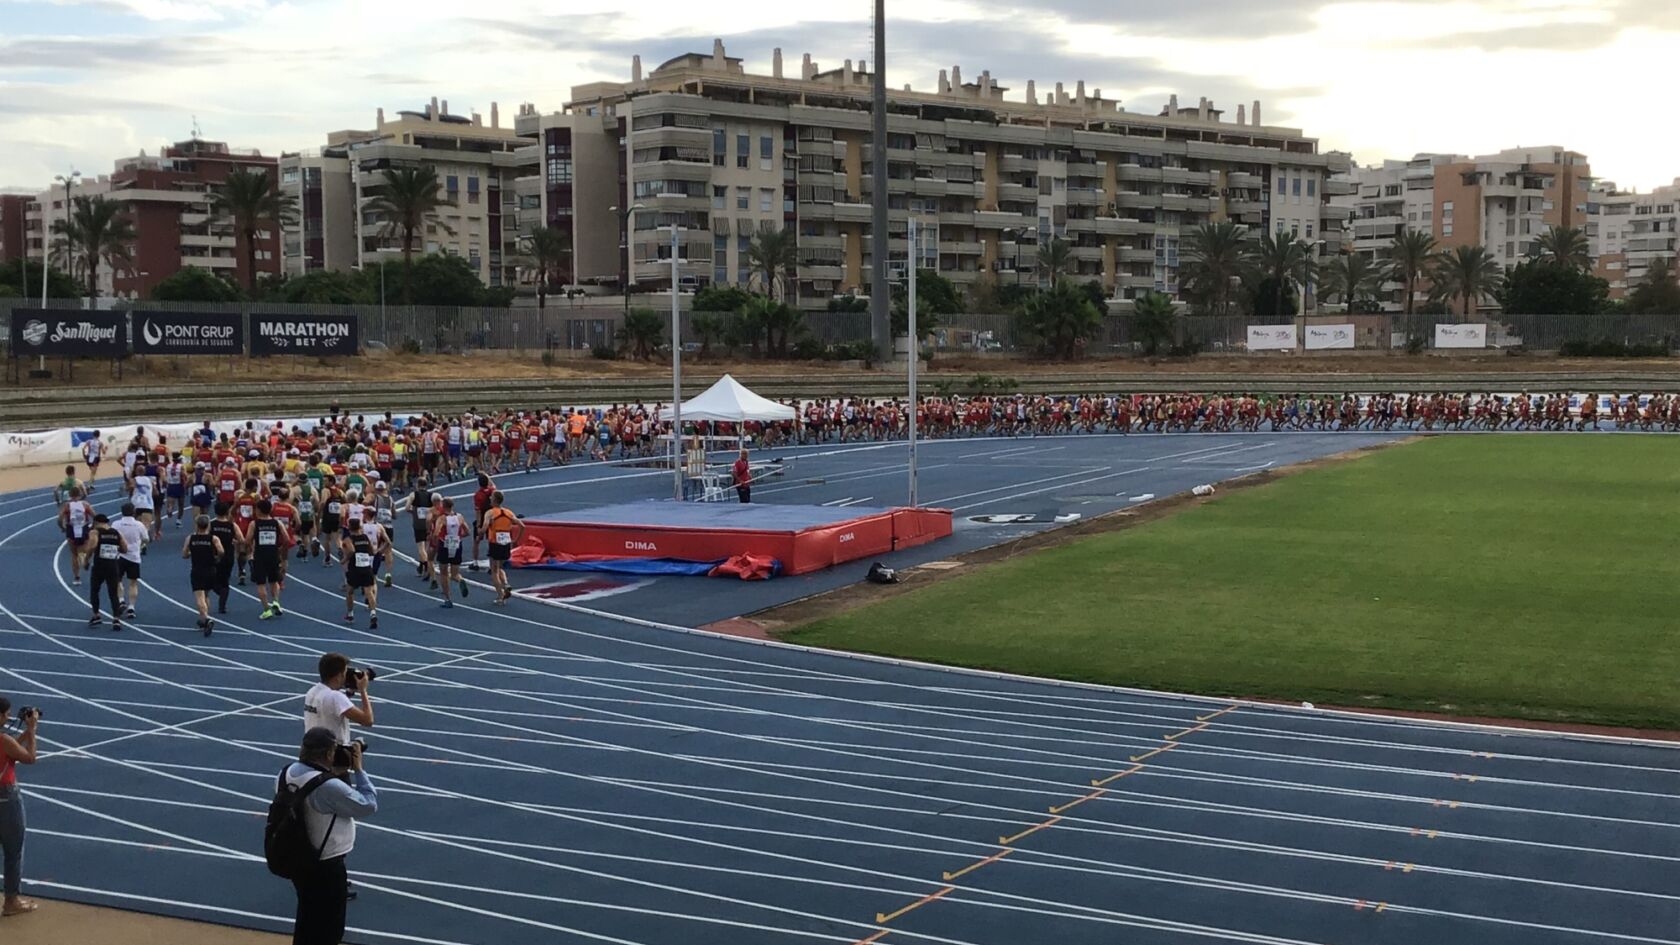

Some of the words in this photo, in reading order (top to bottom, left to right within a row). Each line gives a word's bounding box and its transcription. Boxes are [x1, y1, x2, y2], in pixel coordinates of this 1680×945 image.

[165, 325, 199, 337] PONT
[201, 326, 234, 338] GRUP
[260, 322, 349, 336] MARATHON
[295, 338, 317, 346] BET
[840, 532, 855, 543] DIMA
[625, 541, 657, 551] DIMA
